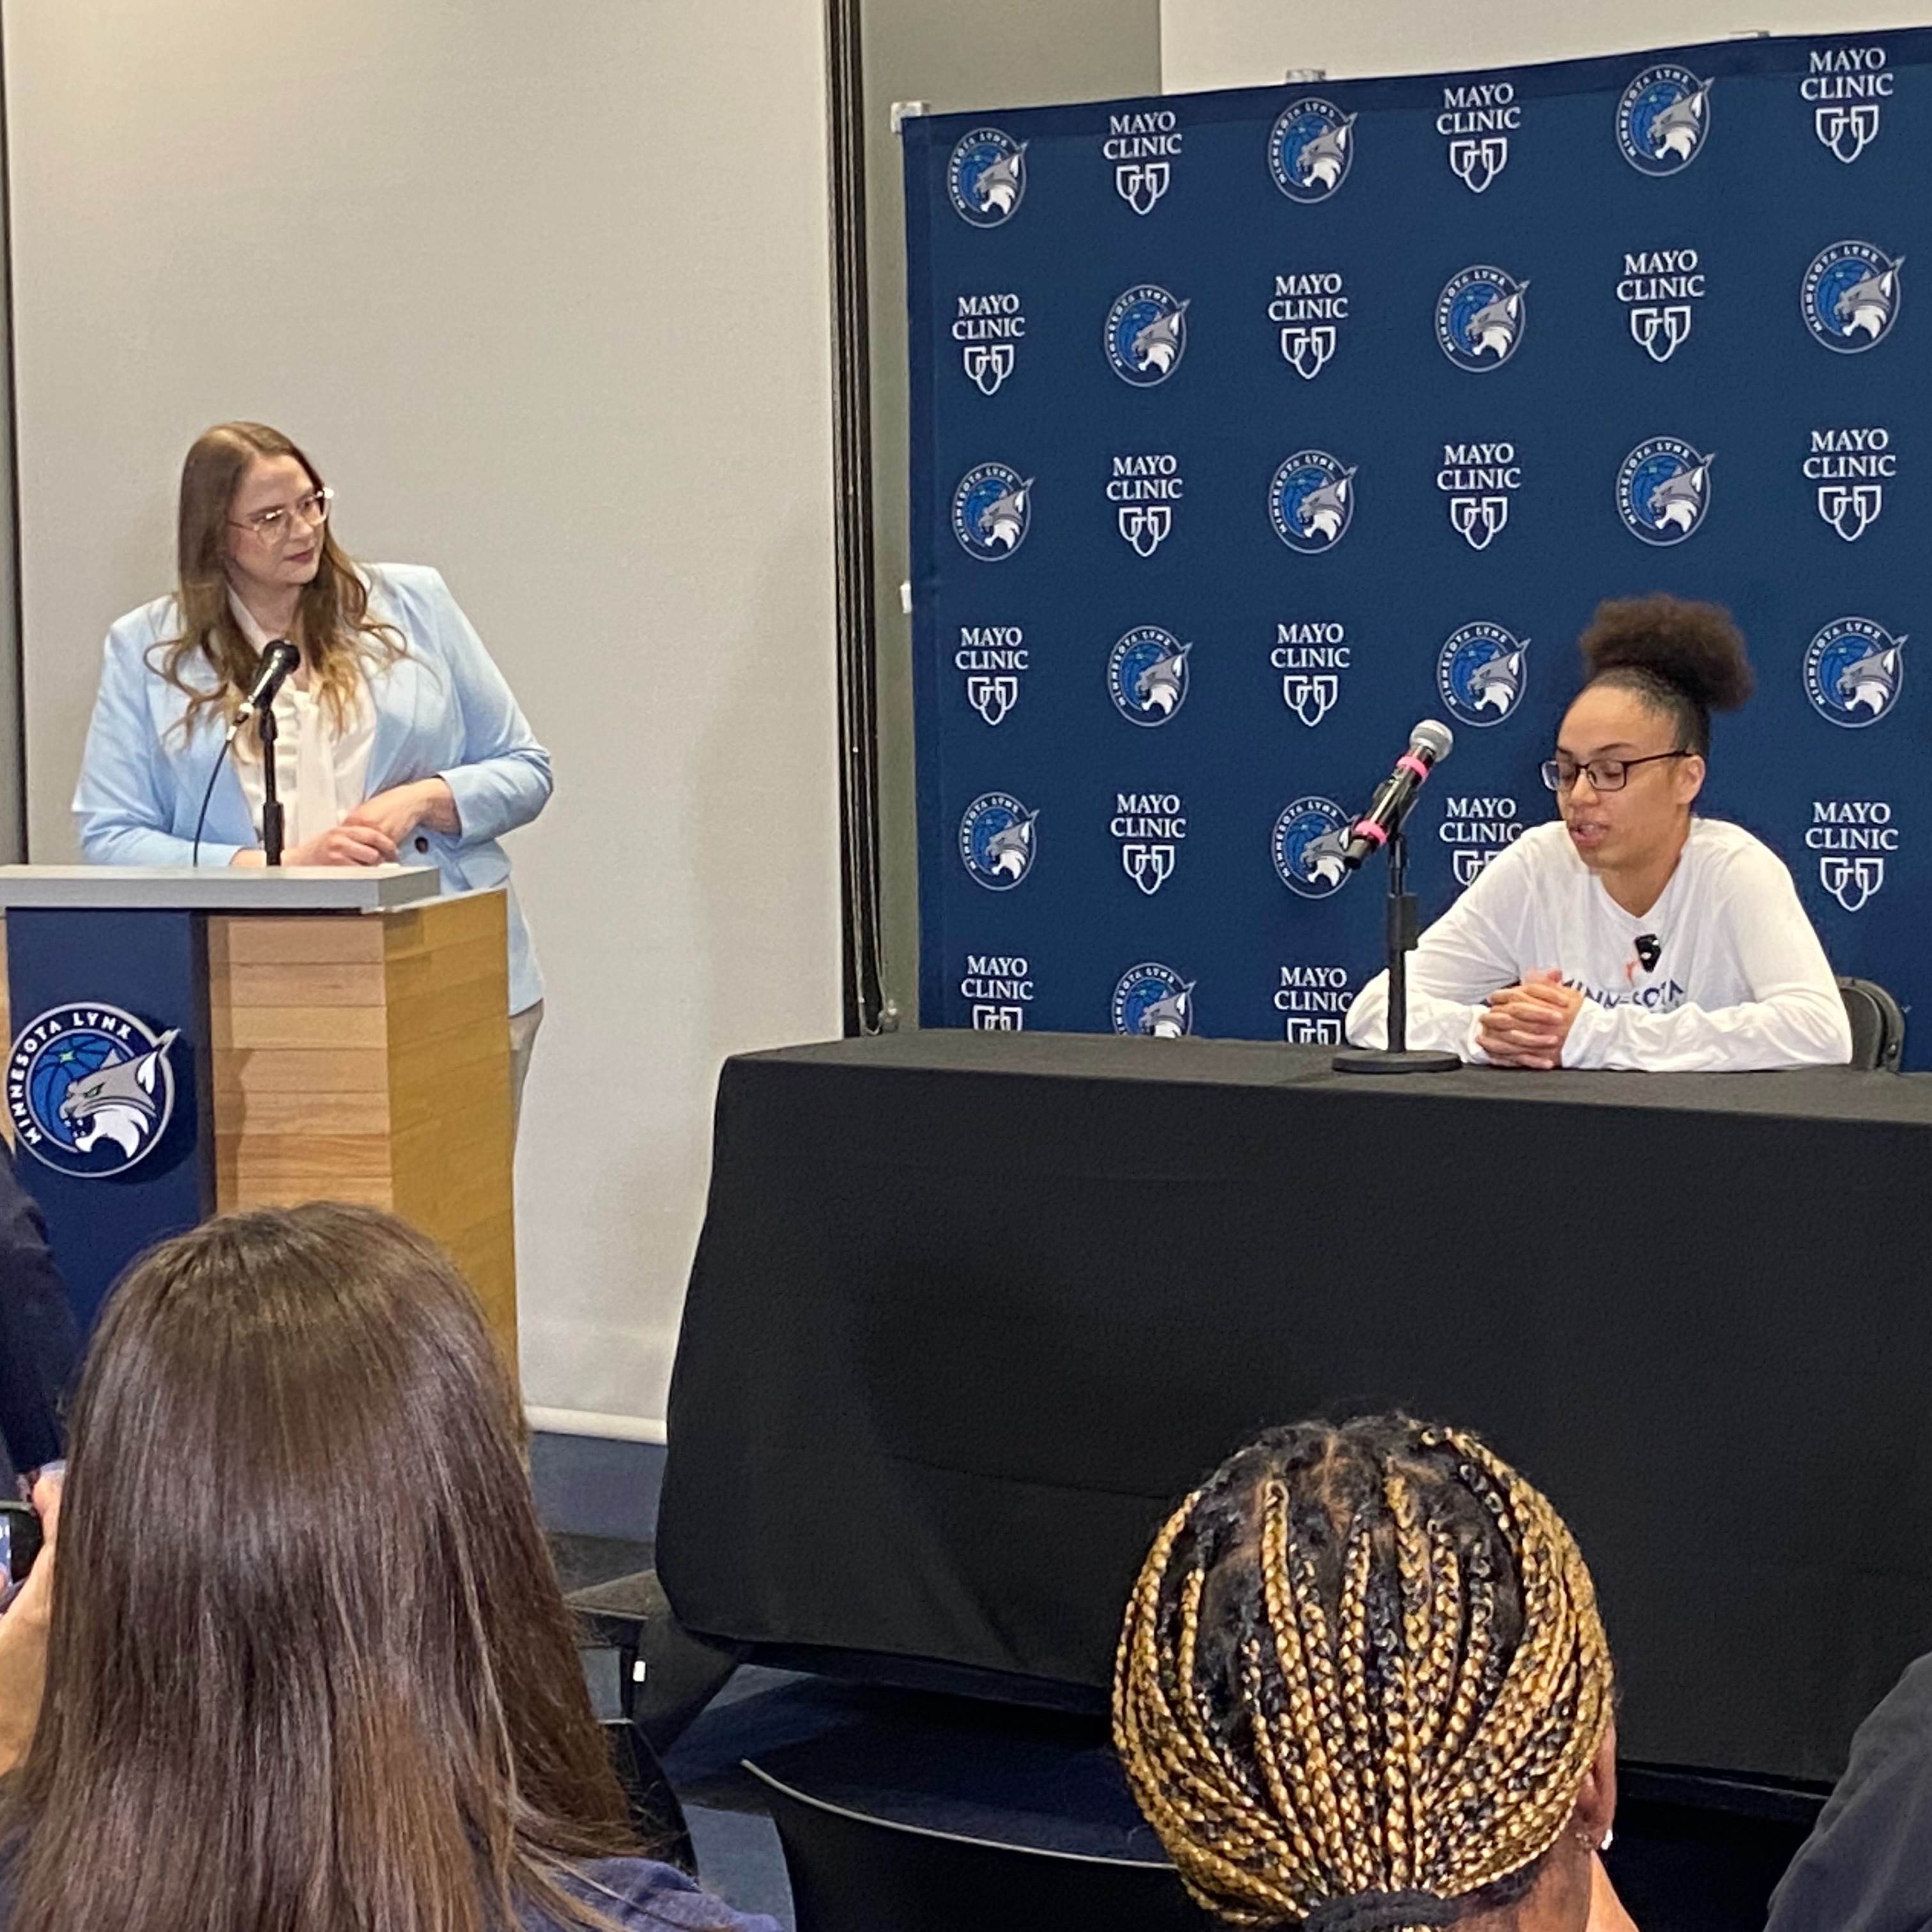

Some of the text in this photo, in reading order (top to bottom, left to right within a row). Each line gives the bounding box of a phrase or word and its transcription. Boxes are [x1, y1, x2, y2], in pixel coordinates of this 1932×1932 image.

[1810, 48, 1886, 73] MAYO
[1444, 82, 1514, 109] MAYO
[1800, 73, 1893, 100] CLINIC
[1110, 111, 1176, 135] MAYO
[1436, 107, 1521, 135] CLINIC
[1103, 134, 1182, 160] CLINIC
[1625, 249, 1698, 275] MAYO
[1275, 273, 1342, 296] MAYO
[1616, 275, 1705, 302] CLINIC
[958, 293, 1019, 317] MAYO
[1268, 297, 1348, 321] CLINIC
[952, 317, 1025, 340] CLINIC
[1811, 428, 1889, 452] MAYO
[1444, 443, 1514, 465] MAYO
[1113, 455, 1177, 477] MAYO
[1803, 455, 1896, 479] CLINIC
[1106, 478, 1183, 501] CLINIC
[1437, 467, 1521, 491] CLINIC
[961, 627, 1022, 647] MAYO
[1278, 623, 1344, 644] MAYO
[955, 650, 1029, 670] CLINIC
[1271, 647, 1350, 668] CLINIC
[1117, 793, 1180, 814] MAYO
[1446, 797, 1516, 818] MAYO
[1813, 802, 1891, 824] MAYO
[1110, 817, 1186, 838] CLINIC
[1805, 827, 1899, 850] CLINIC
[967, 955, 1028, 977] MAYO
[1280, 967, 1347, 988] MAYO
[961, 978, 1034, 1000] CLINIC
[8, 1011, 132, 1145] MINNESOTA LYNX
